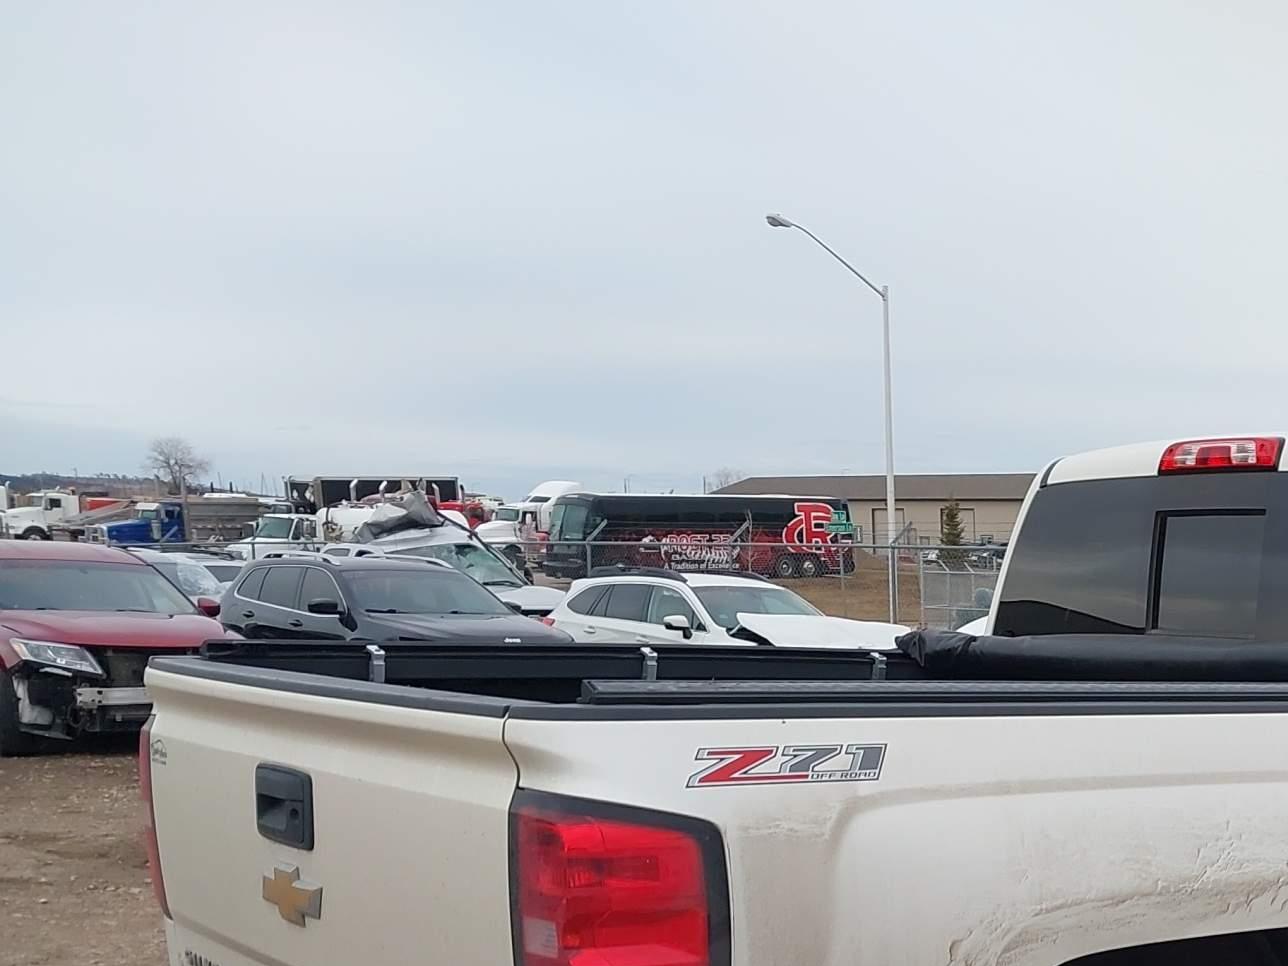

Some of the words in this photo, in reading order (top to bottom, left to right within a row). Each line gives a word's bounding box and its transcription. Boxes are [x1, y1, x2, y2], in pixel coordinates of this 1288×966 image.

[685, 743, 888, 789] Z71
[810, 772, 837, 781] OFF
[839, 770, 877, 780] ROAD
